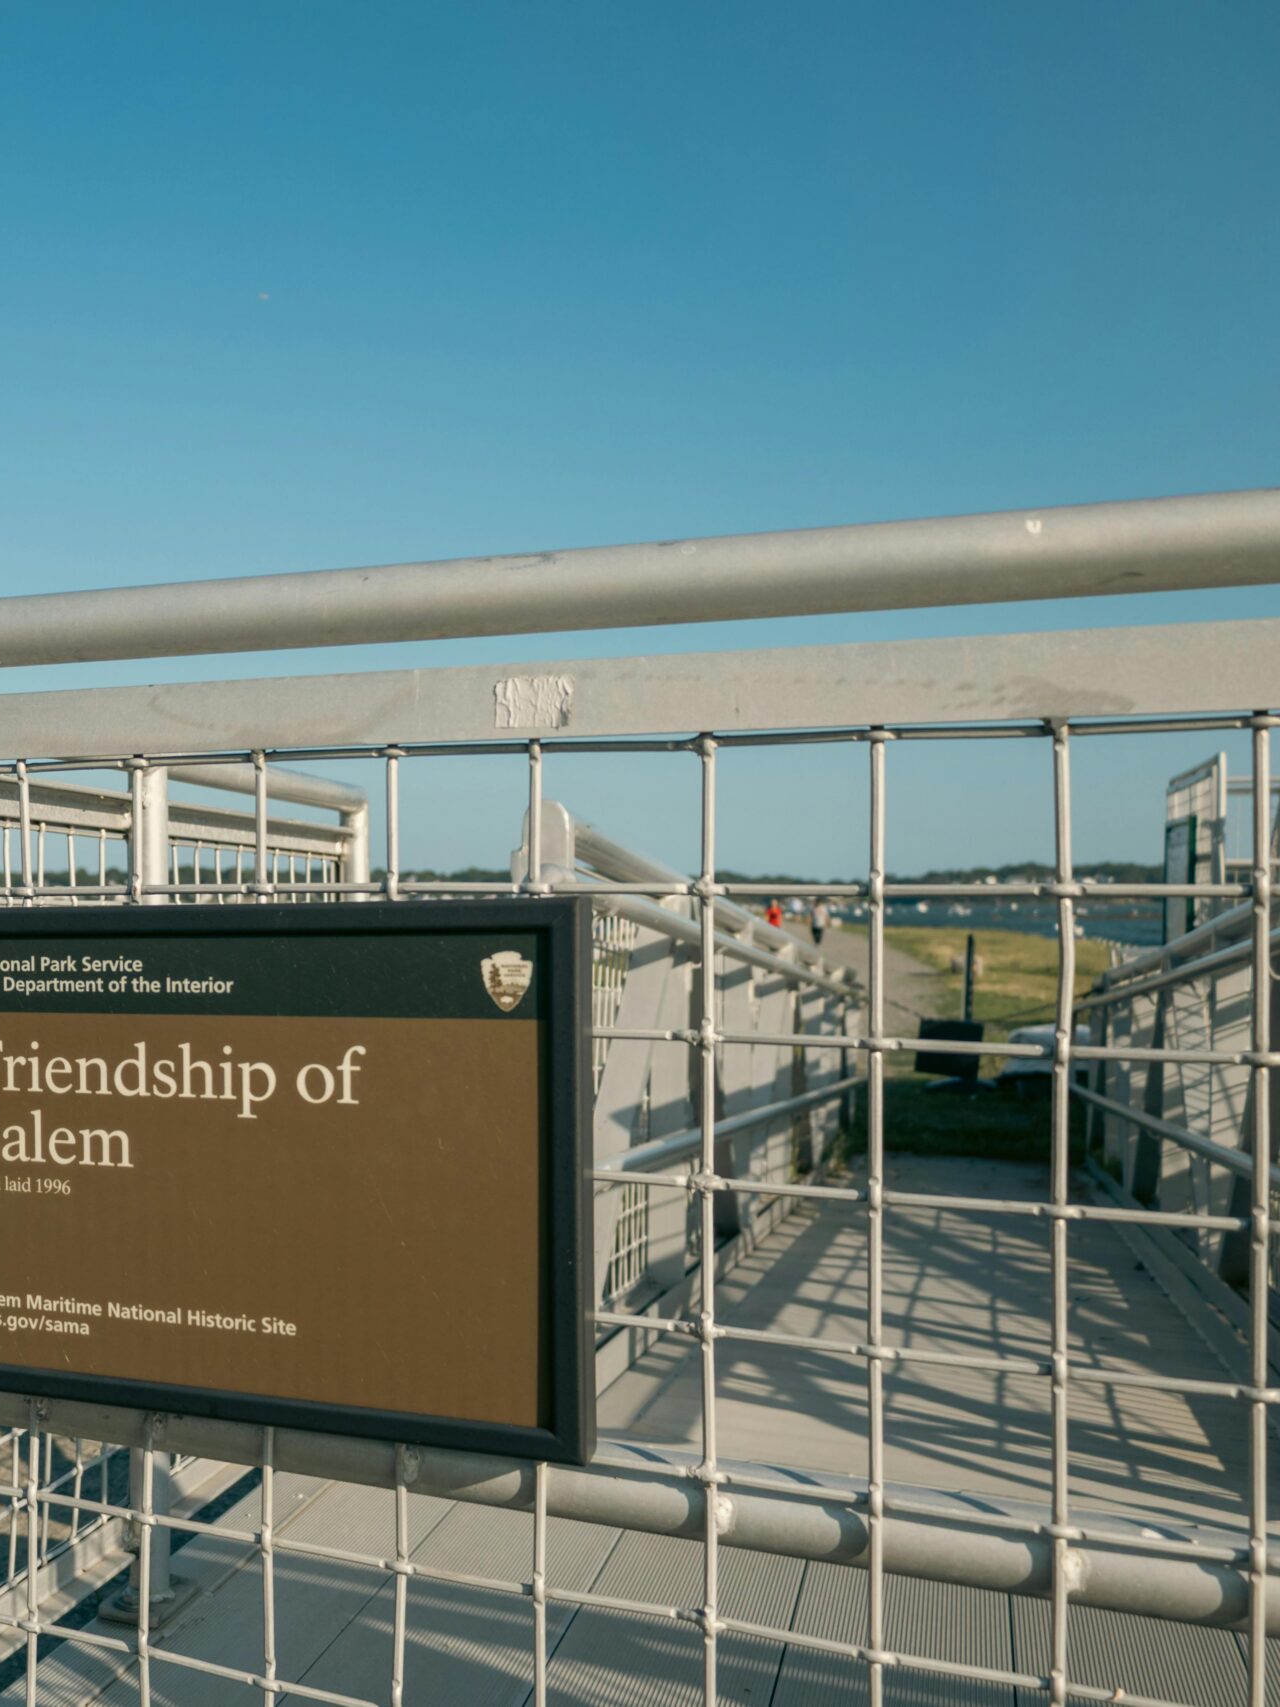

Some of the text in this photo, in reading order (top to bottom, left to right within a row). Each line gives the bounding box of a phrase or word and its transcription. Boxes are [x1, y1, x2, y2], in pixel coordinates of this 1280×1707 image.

[40, 956, 77, 972] Park
[81, 956, 143, 972] Service
[3, 977, 104, 996] Department
[108, 975, 128, 993] of
[131, 977, 161, 993] the
[166, 976, 234, 994] Interior
[295, 1044, 367, 1105] of
[4, 1175, 32, 1193] laid
[36, 1178, 72, 1196] 1996
[26, 1293, 103, 1317] Maritime
[107, 1301, 182, 1325] National
[187, 1309, 257, 1333] Historic
[261, 1316, 297, 1336] Site
